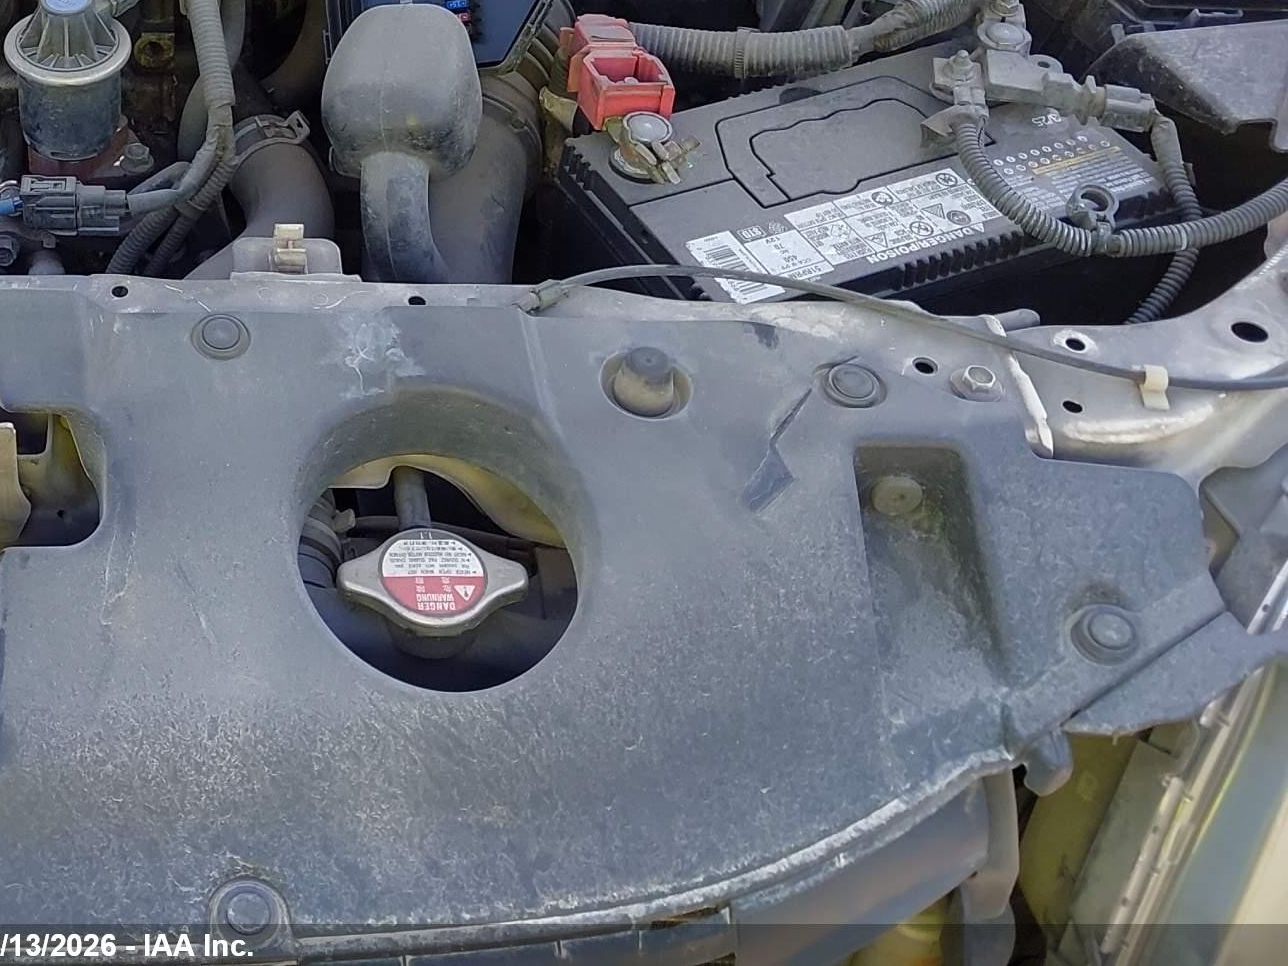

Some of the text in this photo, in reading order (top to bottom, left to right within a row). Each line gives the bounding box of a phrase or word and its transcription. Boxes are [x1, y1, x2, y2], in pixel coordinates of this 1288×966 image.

[865, 228, 972, 265] DANGER/POISON
[415, 593, 455, 602] WARNUNG
[416, 601, 456, 611] DANGER
